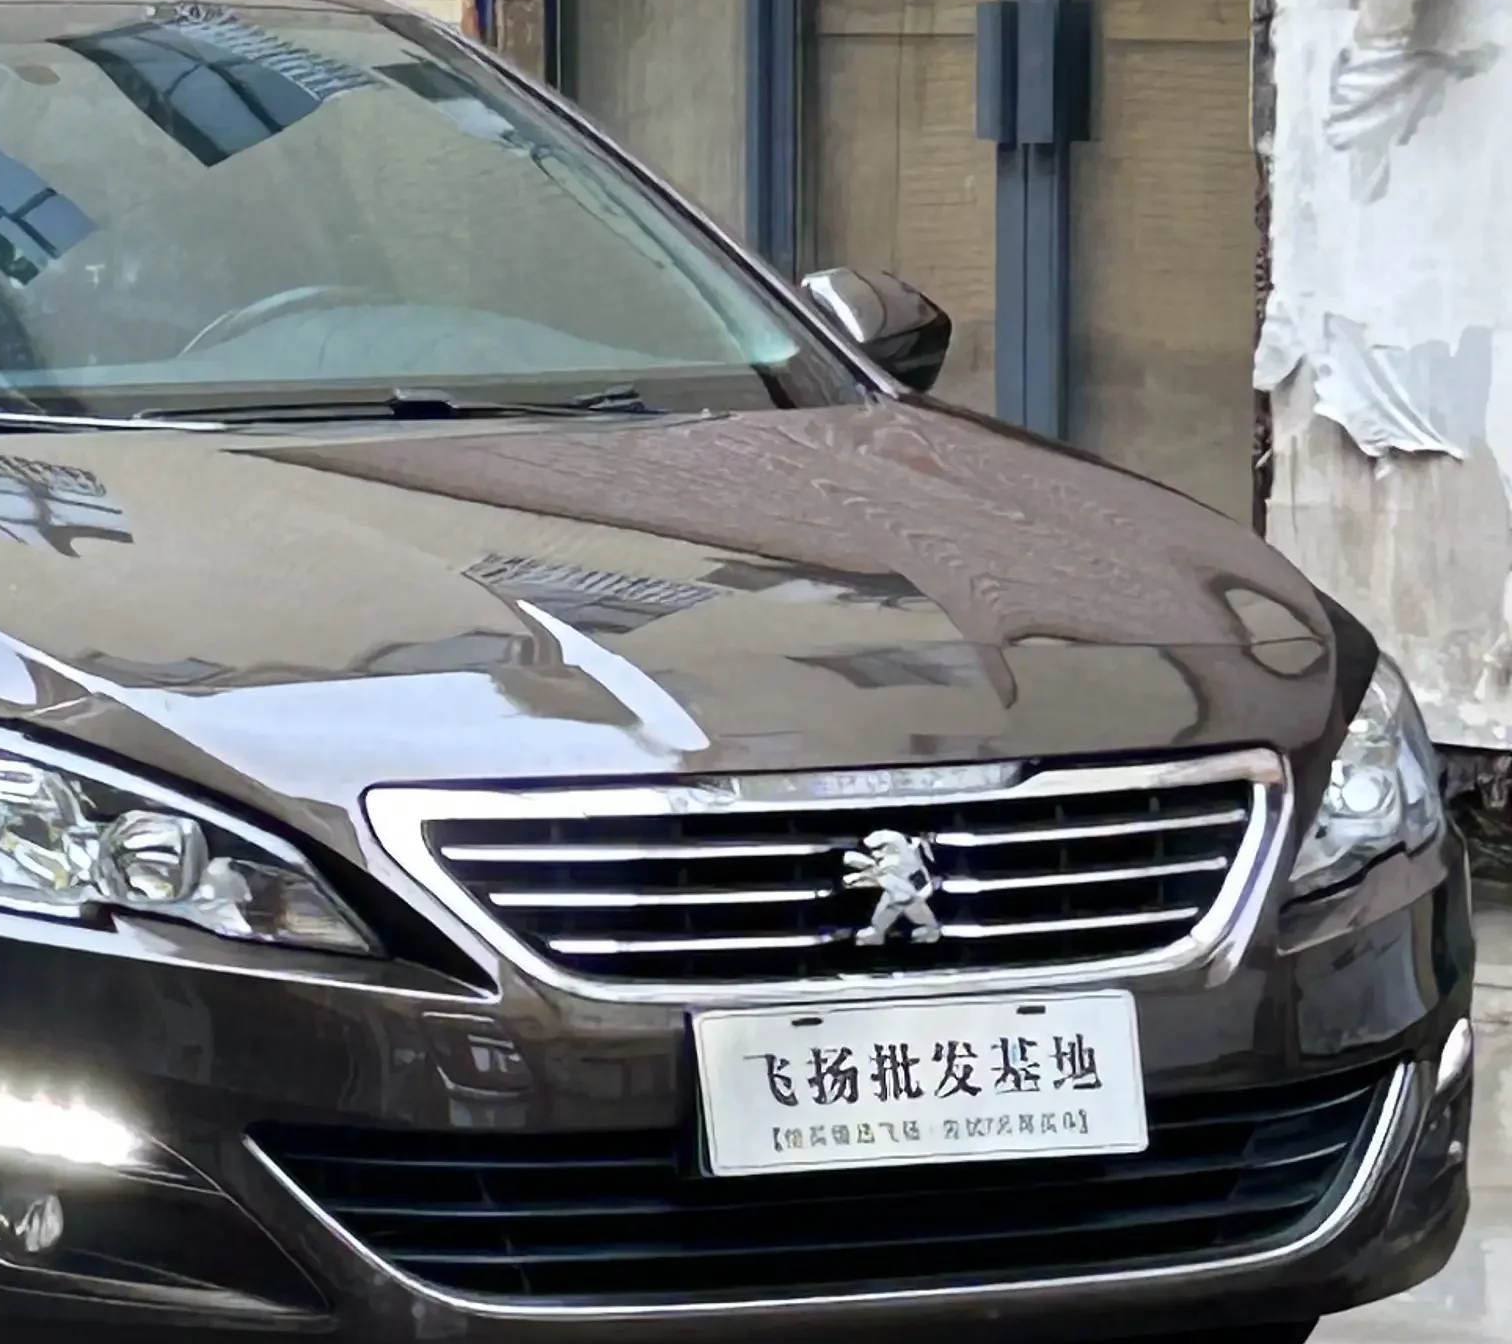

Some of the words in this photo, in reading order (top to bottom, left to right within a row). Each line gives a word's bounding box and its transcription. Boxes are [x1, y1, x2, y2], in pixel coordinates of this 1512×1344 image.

[743, 1032, 1103, 1106] 飞扬批发基地
